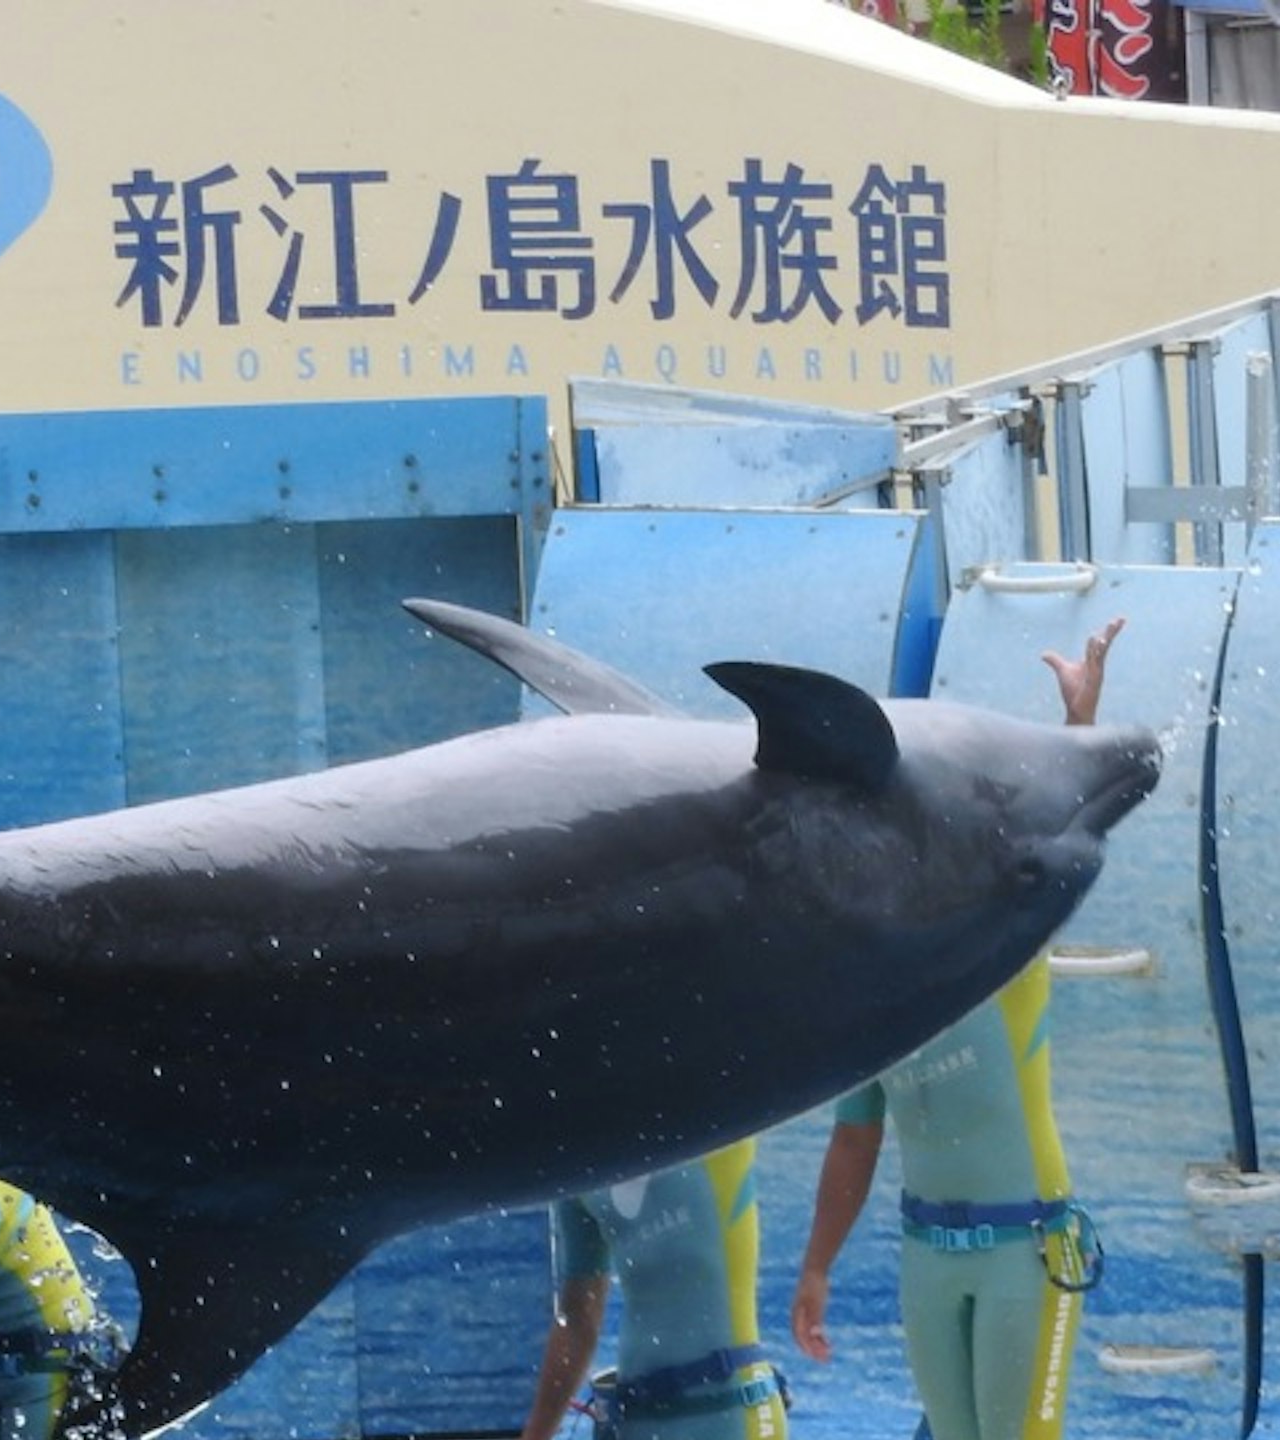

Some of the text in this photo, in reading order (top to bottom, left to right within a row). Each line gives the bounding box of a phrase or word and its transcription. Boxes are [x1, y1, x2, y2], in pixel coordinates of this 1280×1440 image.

[111, 158, 952, 329] 新江ノ島水族館
[121, 343, 954, 387] ENOSHIMA AQUARIUM
